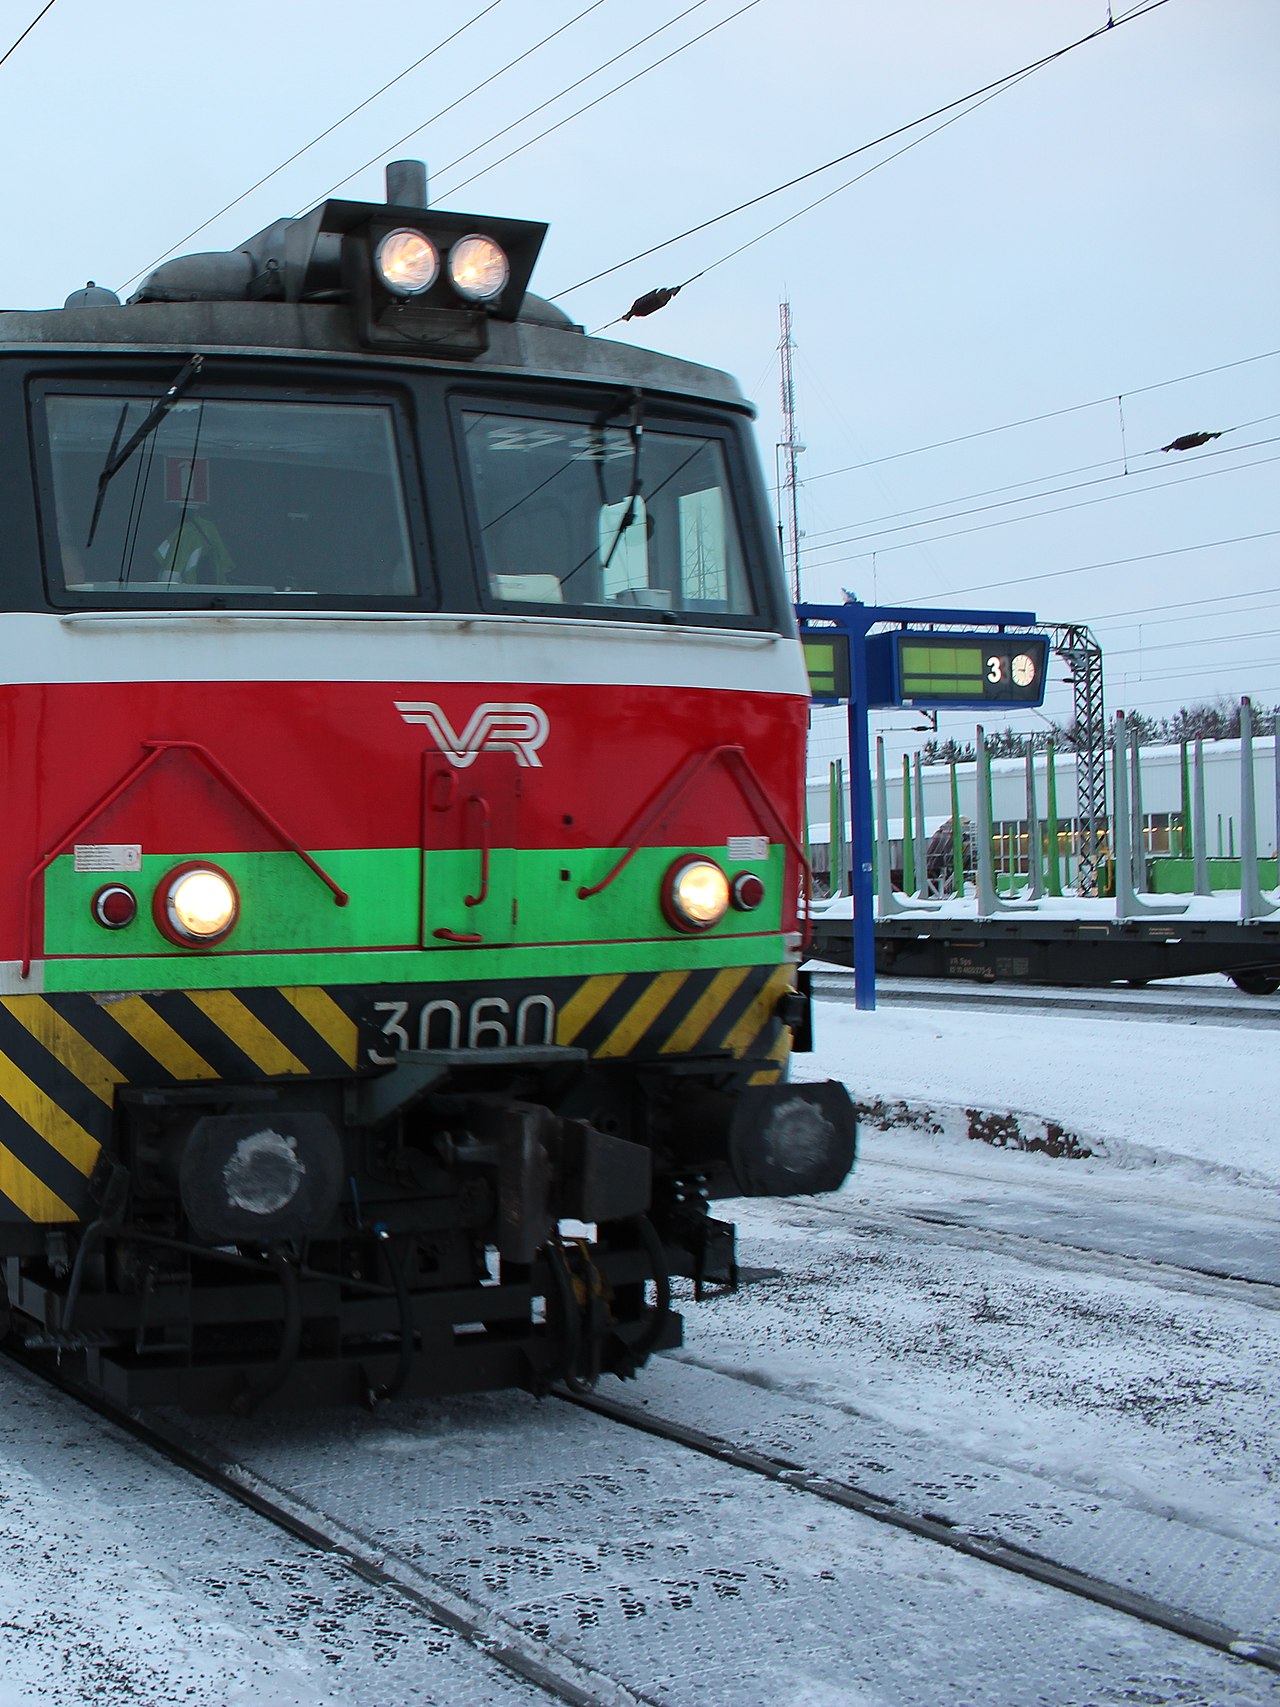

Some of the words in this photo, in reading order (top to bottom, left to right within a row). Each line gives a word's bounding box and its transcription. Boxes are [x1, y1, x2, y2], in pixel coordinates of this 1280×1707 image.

[986, 656, 1002, 683] 3
[393, 701, 550, 768] VR
[368, 994, 555, 1065] 3060
